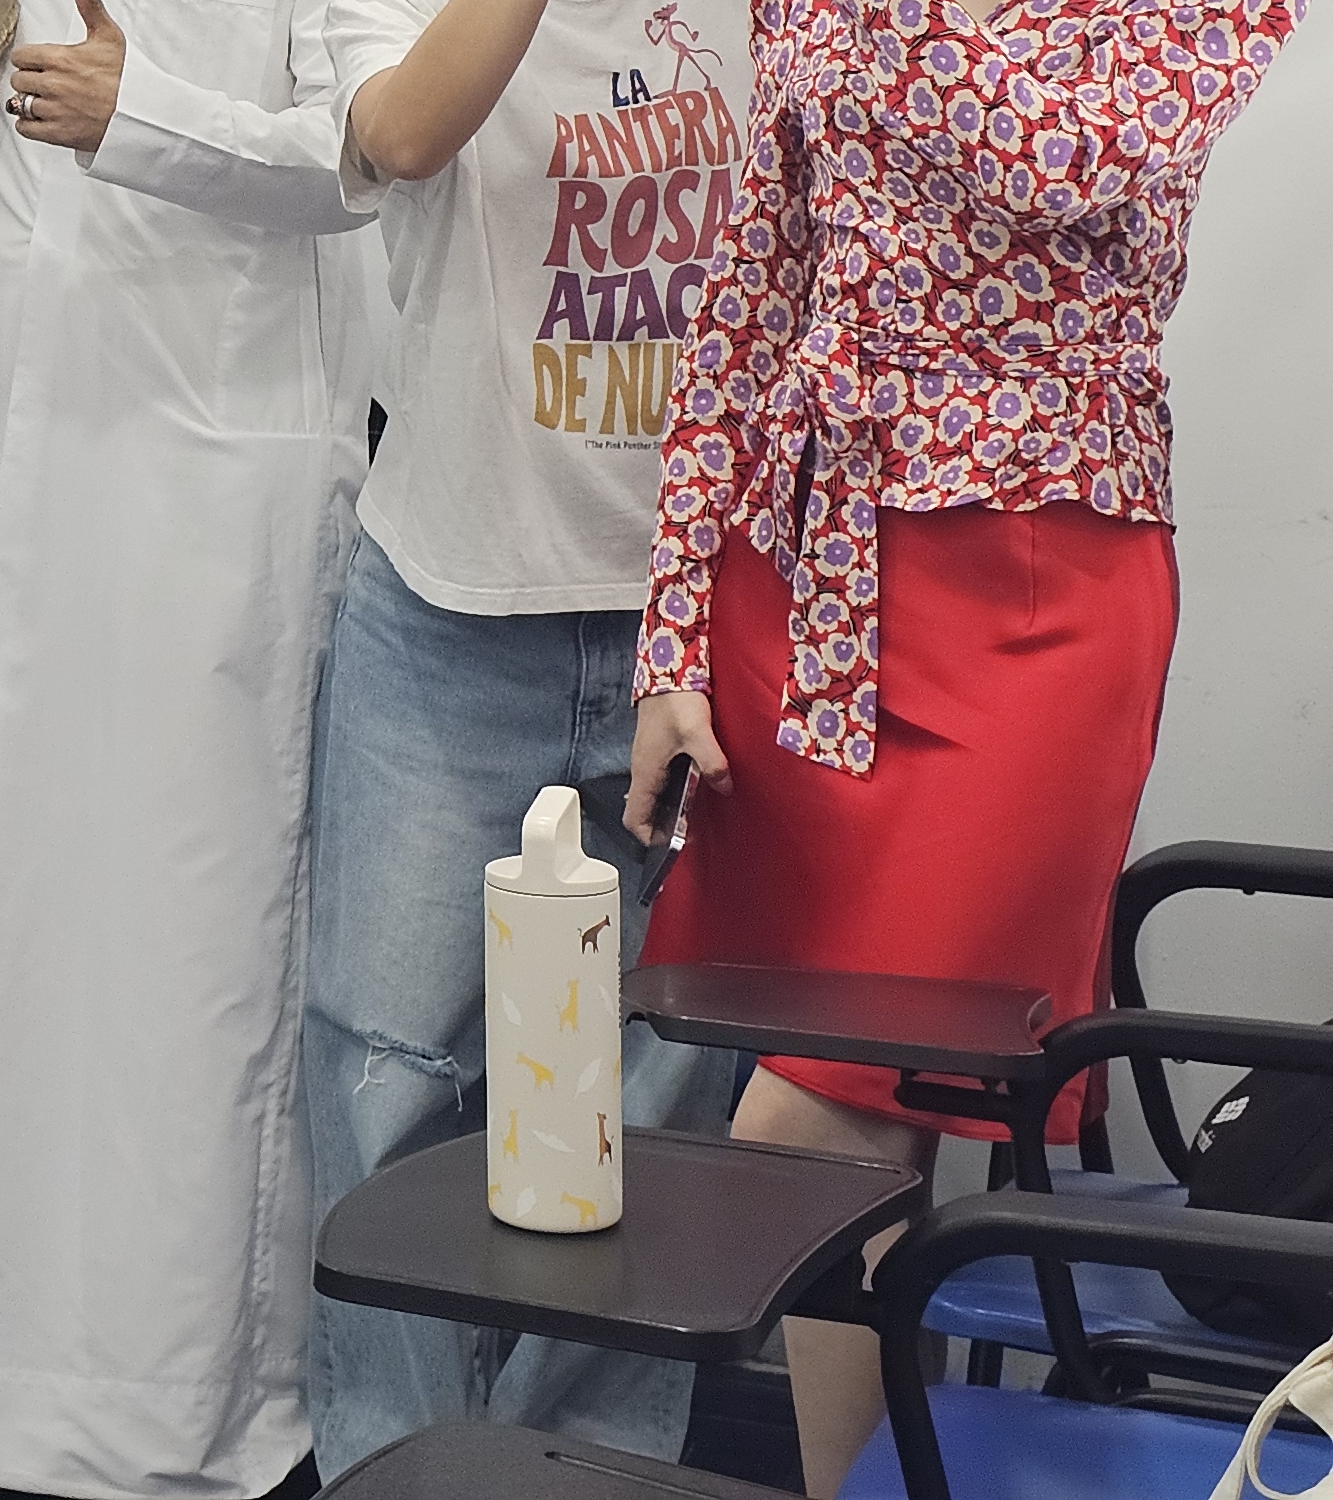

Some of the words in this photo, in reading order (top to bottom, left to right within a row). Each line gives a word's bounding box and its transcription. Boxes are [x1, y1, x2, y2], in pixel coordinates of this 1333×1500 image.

[546, 86, 743, 178] PANTERA
[611, 68, 652, 107] LA
[542, 168, 733, 273] ROSA
[536, 262, 709, 341] ATAC
[533, 341, 592, 432] DE
[598, 341, 675, 437] NU
